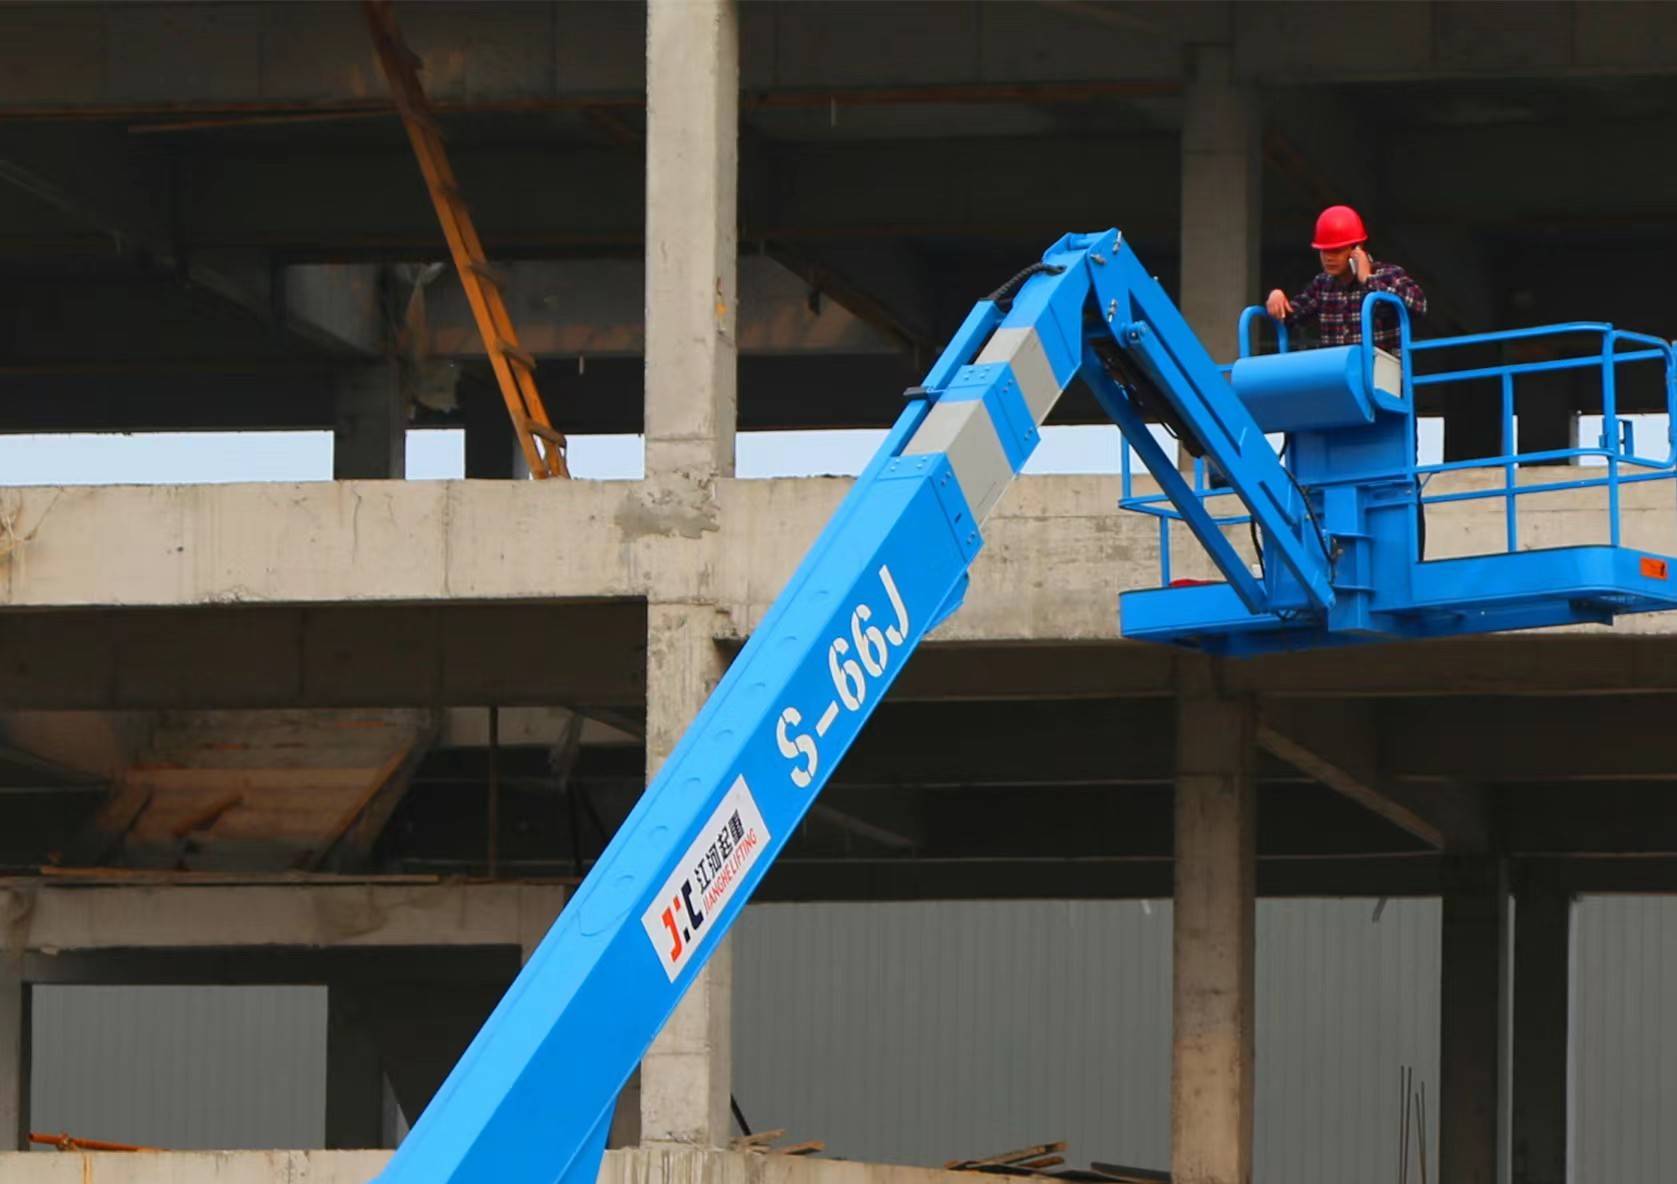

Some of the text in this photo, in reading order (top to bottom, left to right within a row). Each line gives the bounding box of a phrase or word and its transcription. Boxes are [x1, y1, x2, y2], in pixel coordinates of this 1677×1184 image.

[776, 564, 909, 788] S-66J
[694, 808, 745, 894] 江河起重
[703, 828, 757, 915] JIANGHE LIFTING
